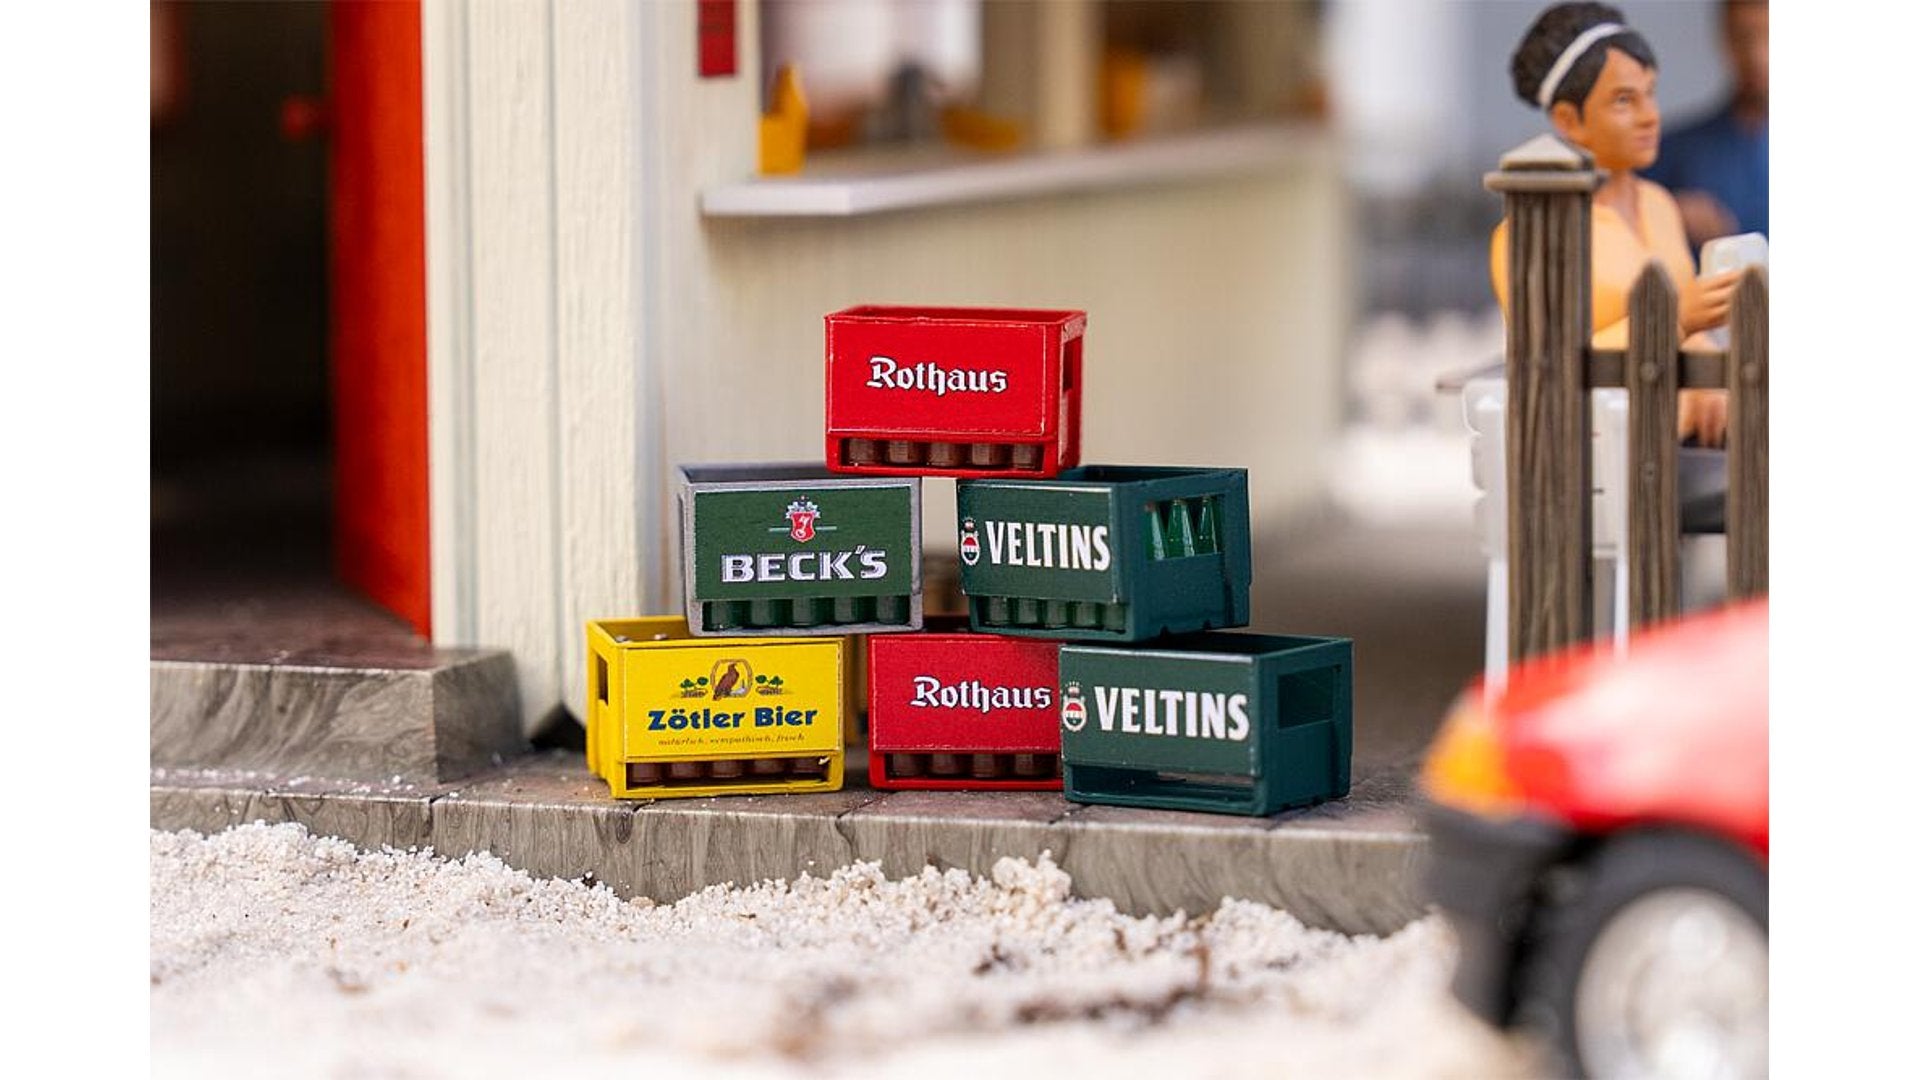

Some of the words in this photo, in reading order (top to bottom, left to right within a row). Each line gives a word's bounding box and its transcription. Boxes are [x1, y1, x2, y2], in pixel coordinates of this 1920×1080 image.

[866, 356, 1008, 396] Rothaus
[721, 545, 889, 583] BECK'S
[986, 520, 1111, 572] VELTINS
[910, 676, 1053, 714] Rothaus
[1094, 685, 1250, 742] VELTINS
[647, 708, 746, 731] Zötler
[755, 706, 818, 728] Bier
